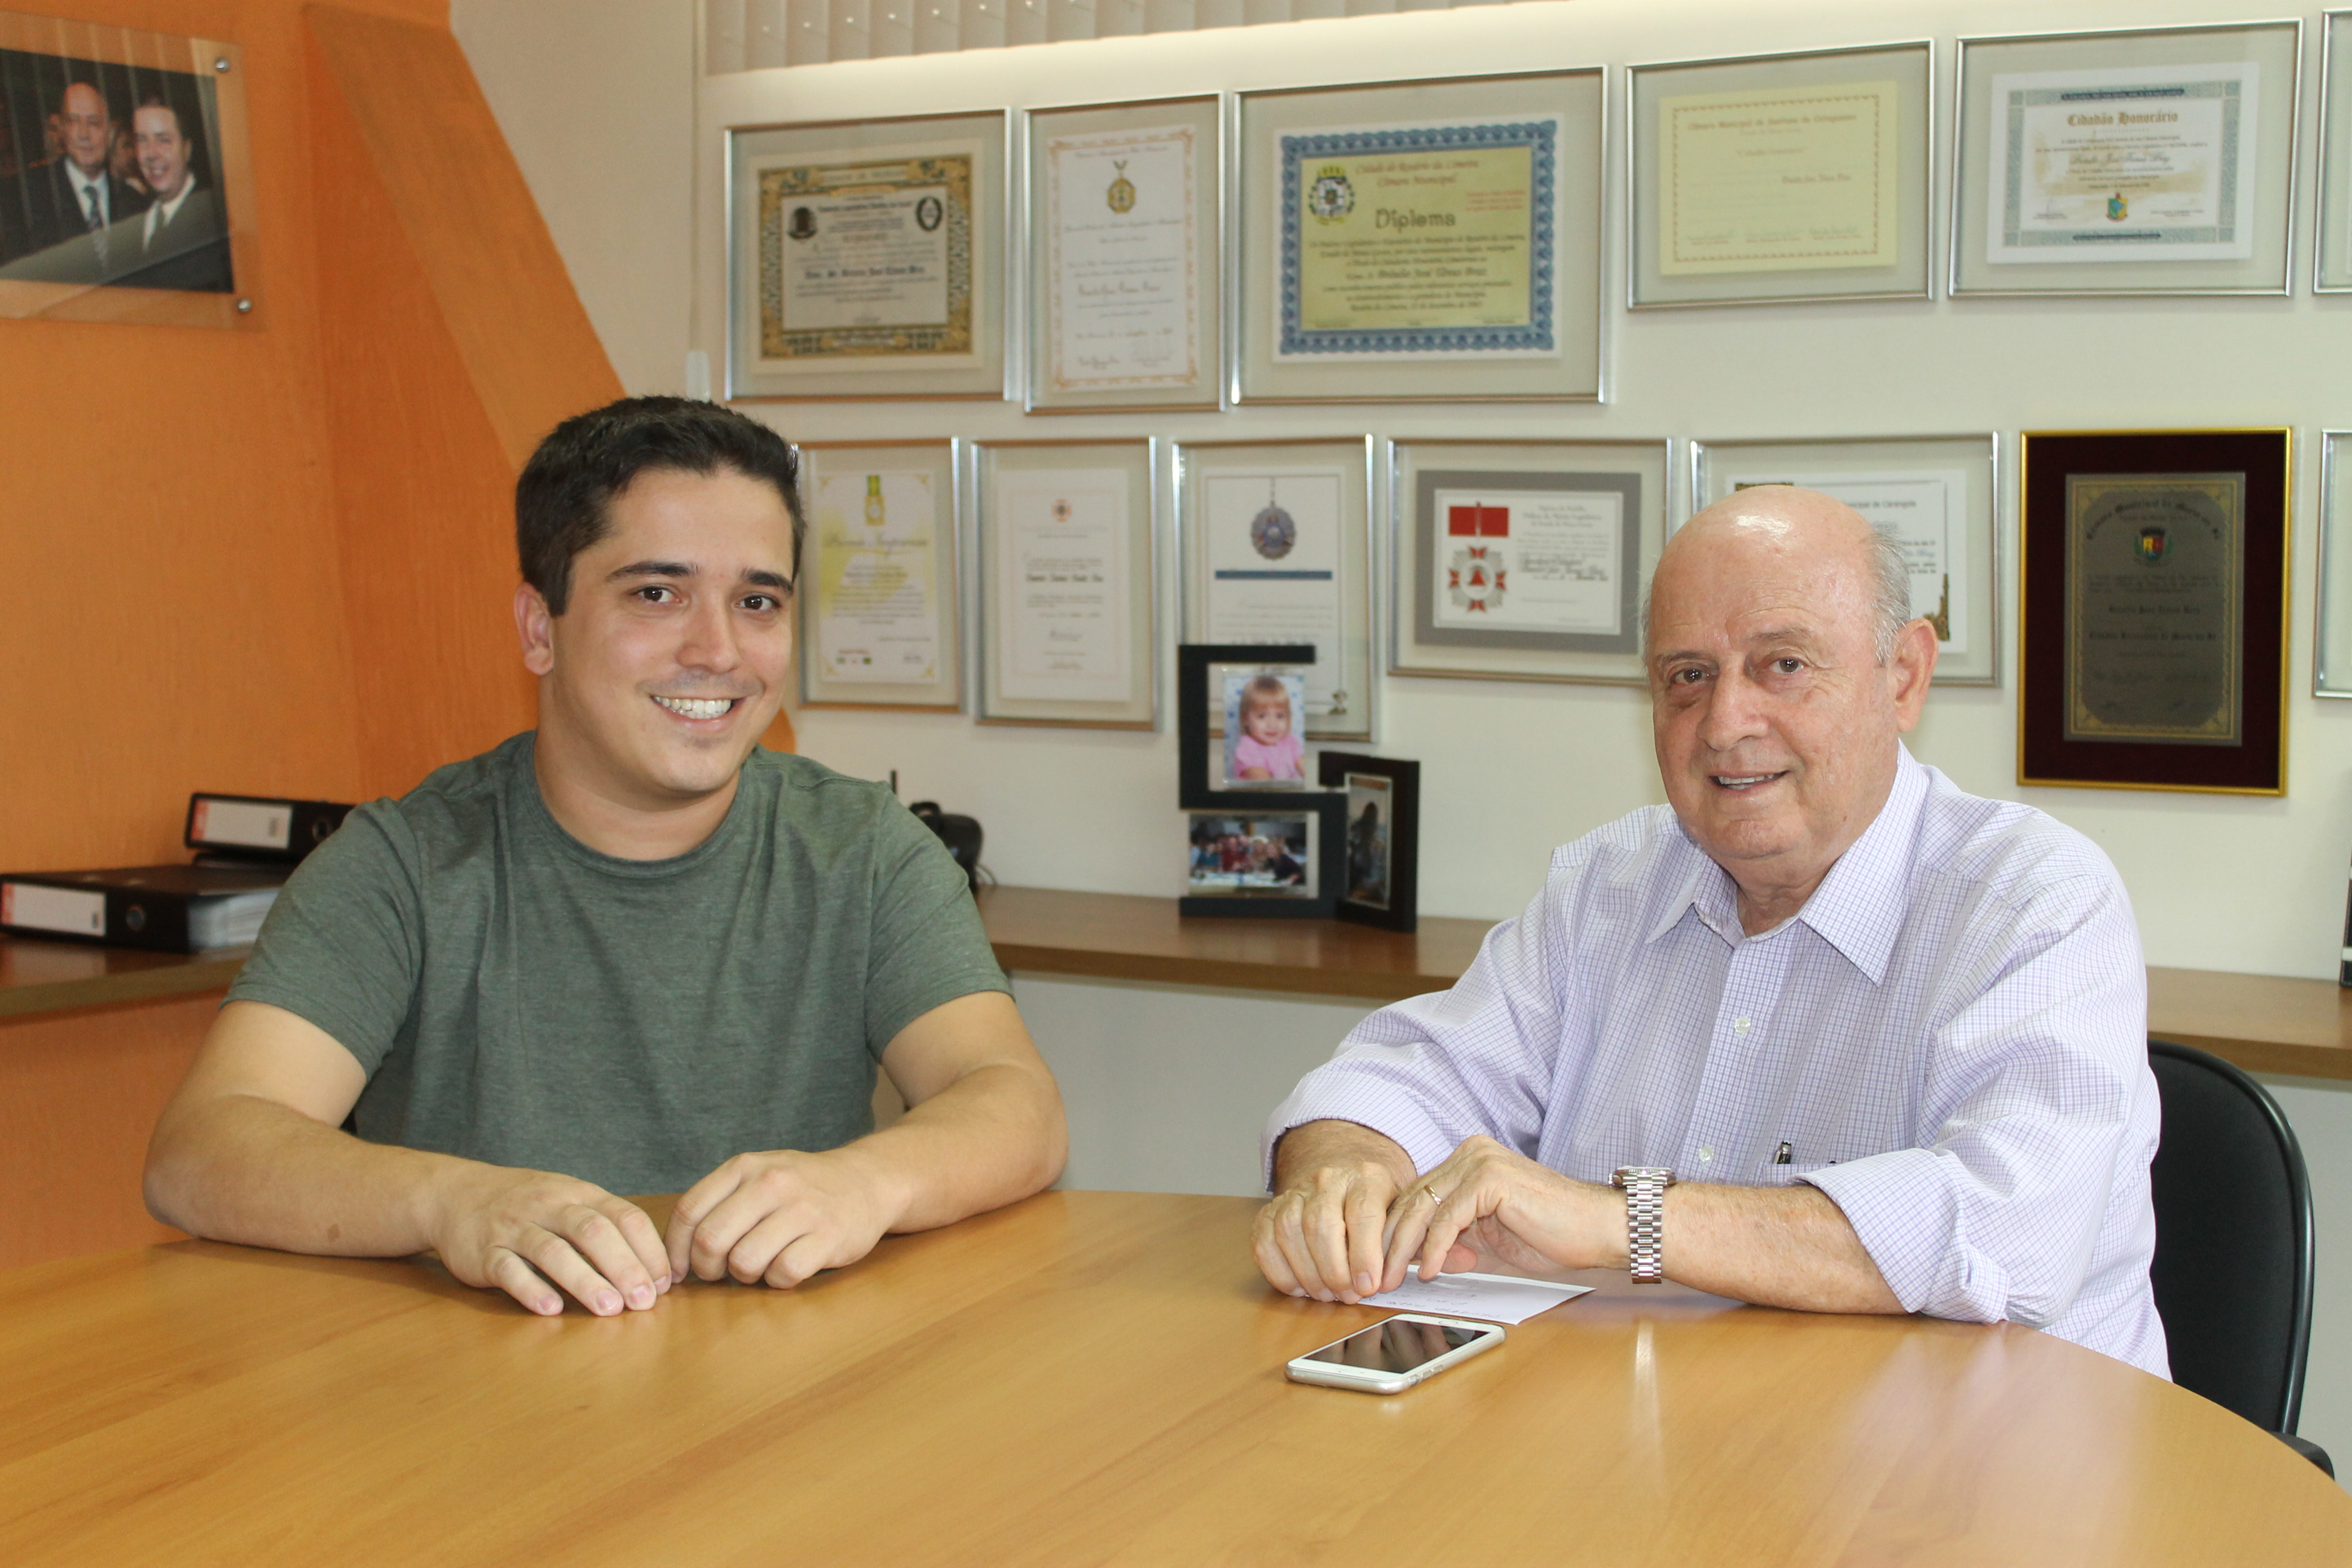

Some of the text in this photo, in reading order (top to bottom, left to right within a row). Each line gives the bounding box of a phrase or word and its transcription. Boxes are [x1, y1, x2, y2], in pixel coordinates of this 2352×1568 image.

[2067, 110, 2177, 127] Cidadão Honorário
[1375, 209, 1456, 233] Diploma
